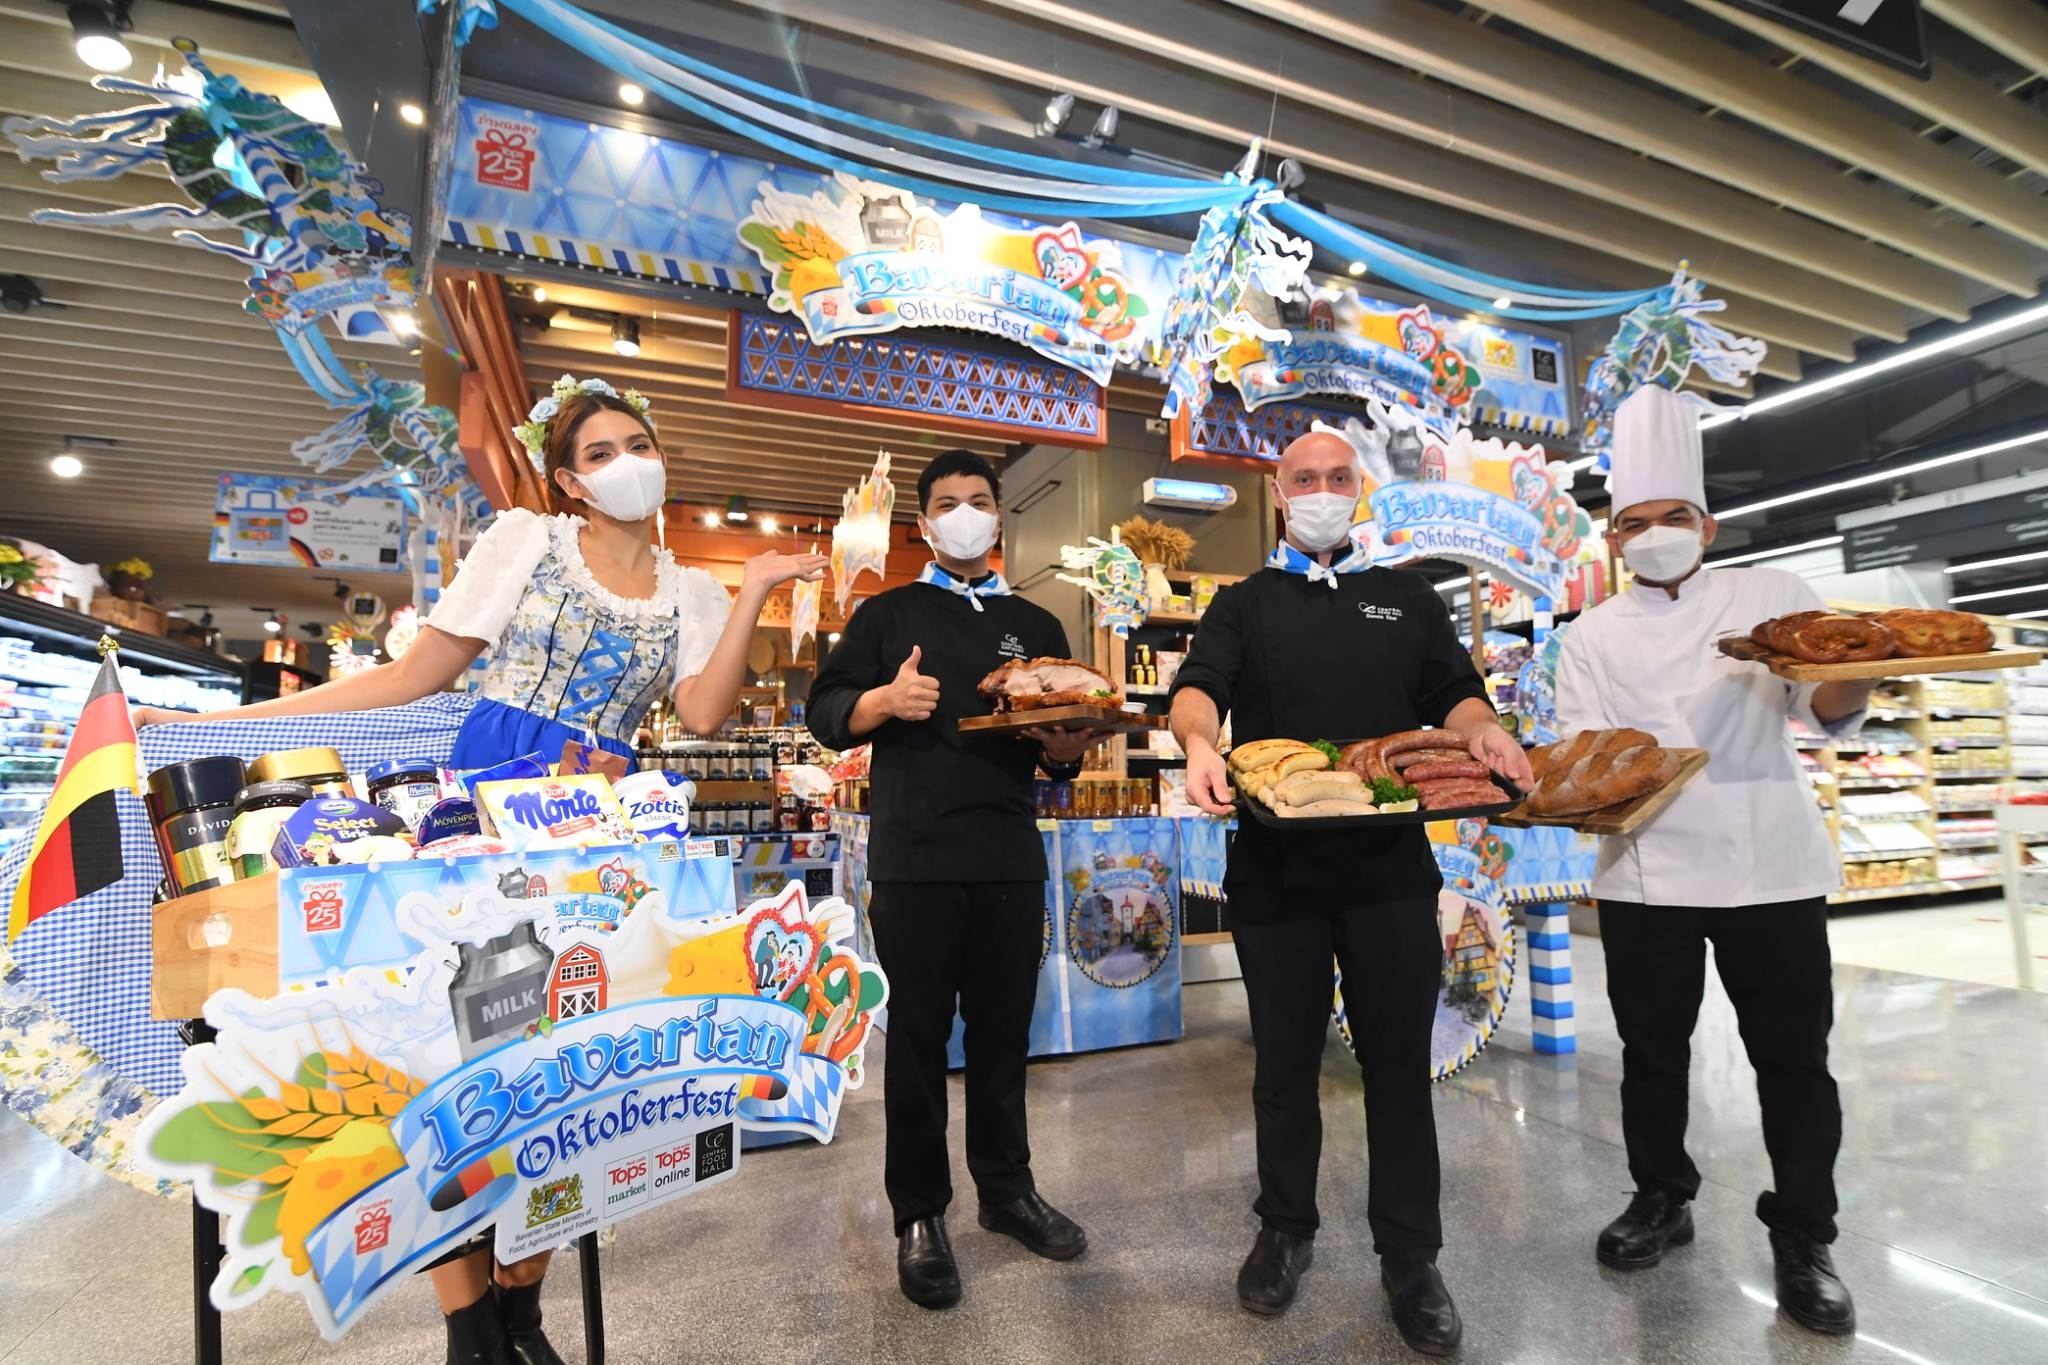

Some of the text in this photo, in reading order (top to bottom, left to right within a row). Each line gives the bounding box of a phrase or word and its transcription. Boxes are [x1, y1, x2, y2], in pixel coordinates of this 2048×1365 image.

[482, 151, 524, 181] 25
[875, 227, 905, 239] MILK
[852, 259, 1071, 329] Bavarian
[897, 299, 1031, 342] Oktoberfest
[1304, 371, 1399, 402] Oktoberfest
[1380, 489, 1536, 550] Bavarian
[1412, 526, 1508, 562] Oktoberfest
[434, 812, 478, 828] MÖVENPIC
[504, 788, 600, 830] Monte
[630, 799, 685, 819] Zottis
[187, 818, 231, 836] DAVID
[313, 816, 378, 832] Select
[338, 829, 370, 840] Brie
[507, 887, 526, 898] MILK
[308, 906, 337, 925] 25
[553, 895, 620, 921] arian
[481, 988, 537, 1025] MILK
[424, 998, 792, 1172] Bavarian
[516, 1076, 739, 1180] Oktoberfest
[655, 1147, 691, 1169] Tops
[702, 1147, 726, 1160] CENTRAL
[702, 1153, 726, 1166] FOOD
[608, 1162, 647, 1186] Tops
[654, 1167, 690, 1188] online
[702, 1161, 727, 1176] HALL
[607, 1183, 647, 1205] market
[515, 1207, 592, 1242] Bavarian State Ministry of
[528, 1230, 562, 1248] Agriculture
[562, 1224, 574, 1234] and
[575, 1216, 599, 1229] Forestry
[358, 1226, 386, 1246] 25
